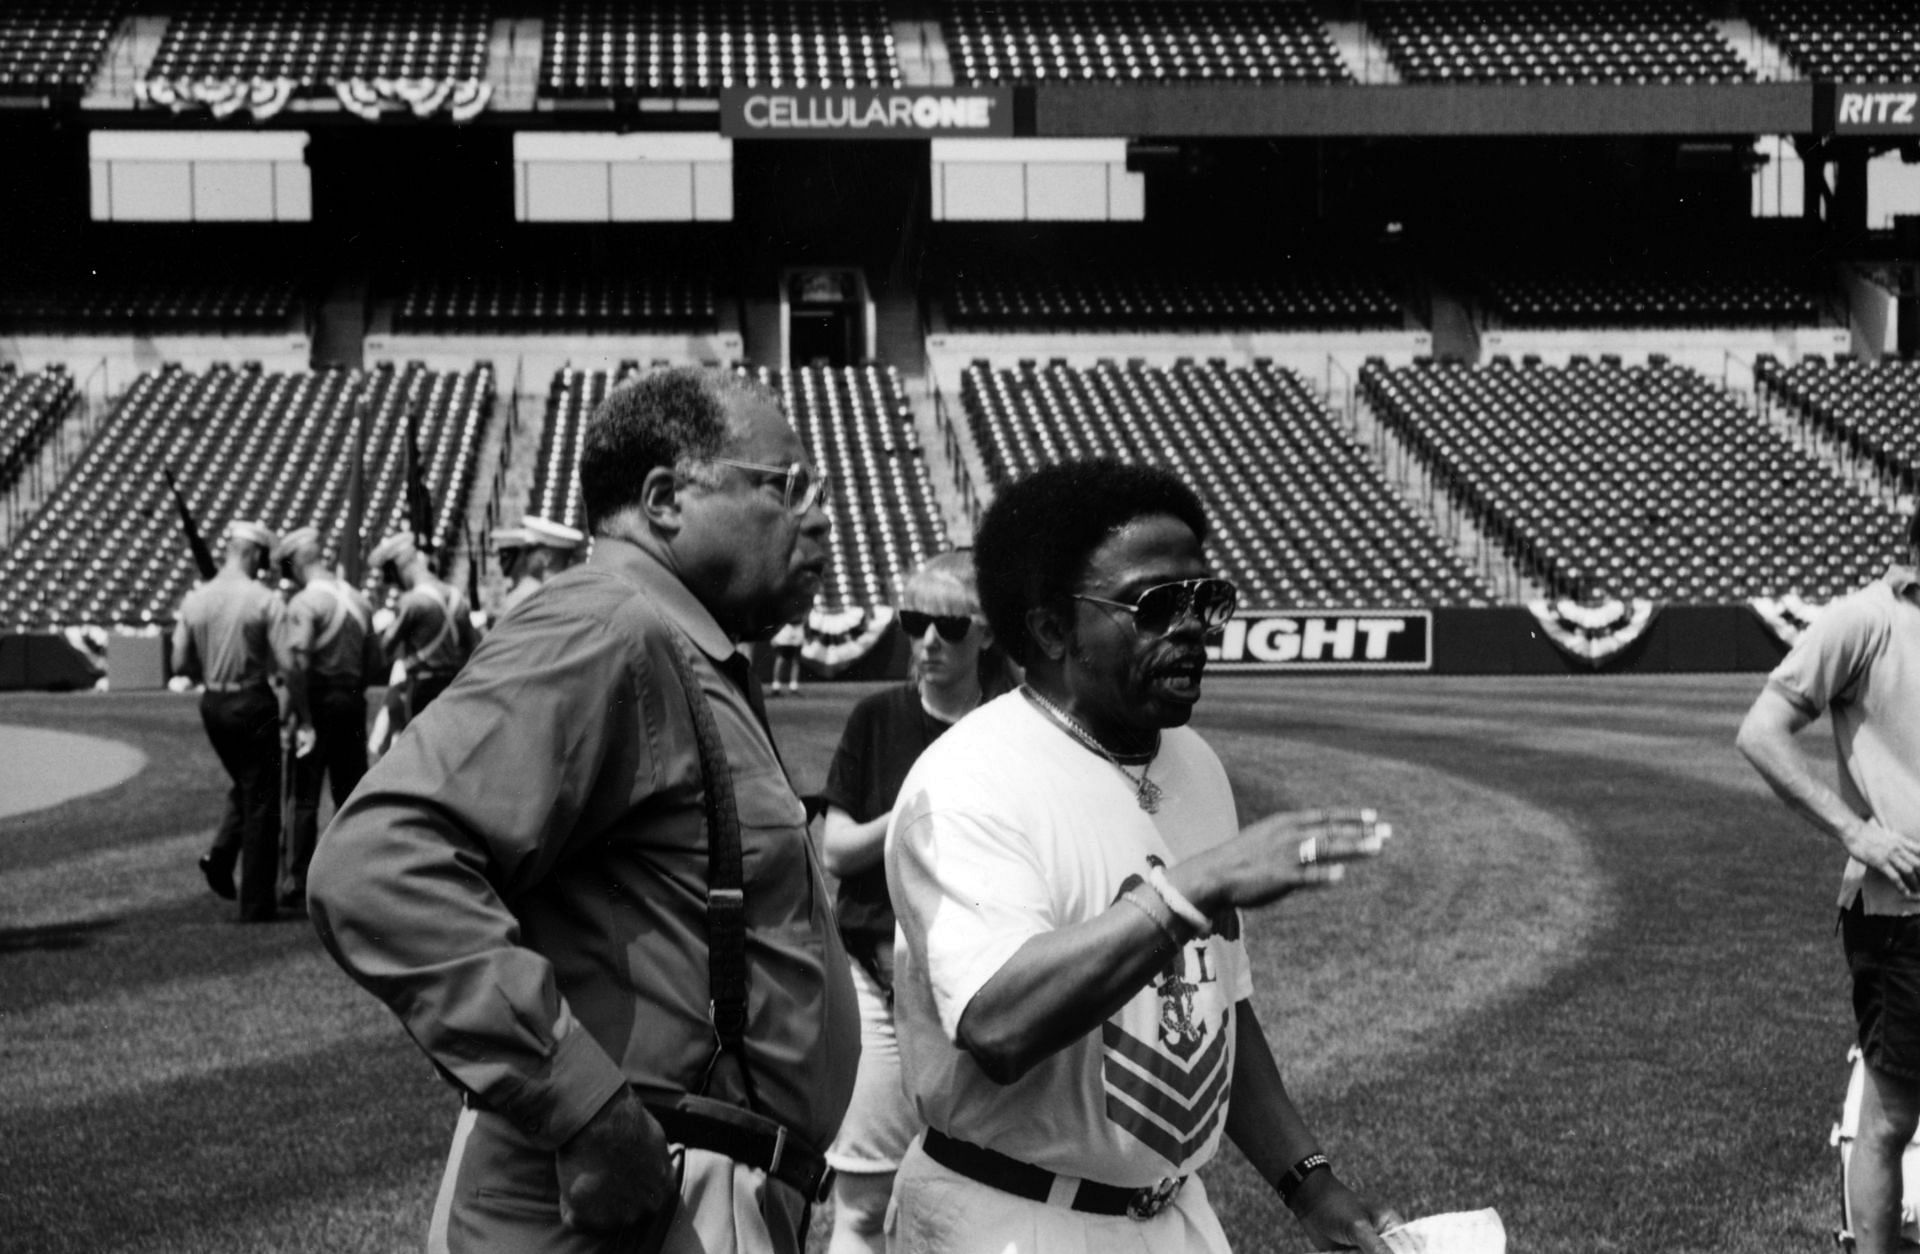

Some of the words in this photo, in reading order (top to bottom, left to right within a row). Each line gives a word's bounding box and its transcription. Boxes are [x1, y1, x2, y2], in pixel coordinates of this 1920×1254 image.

[744, 95, 991, 127] CELLULARONE
[1839, 92, 1918, 123] RITZ
[1205, 618, 1406, 662] IGHT
